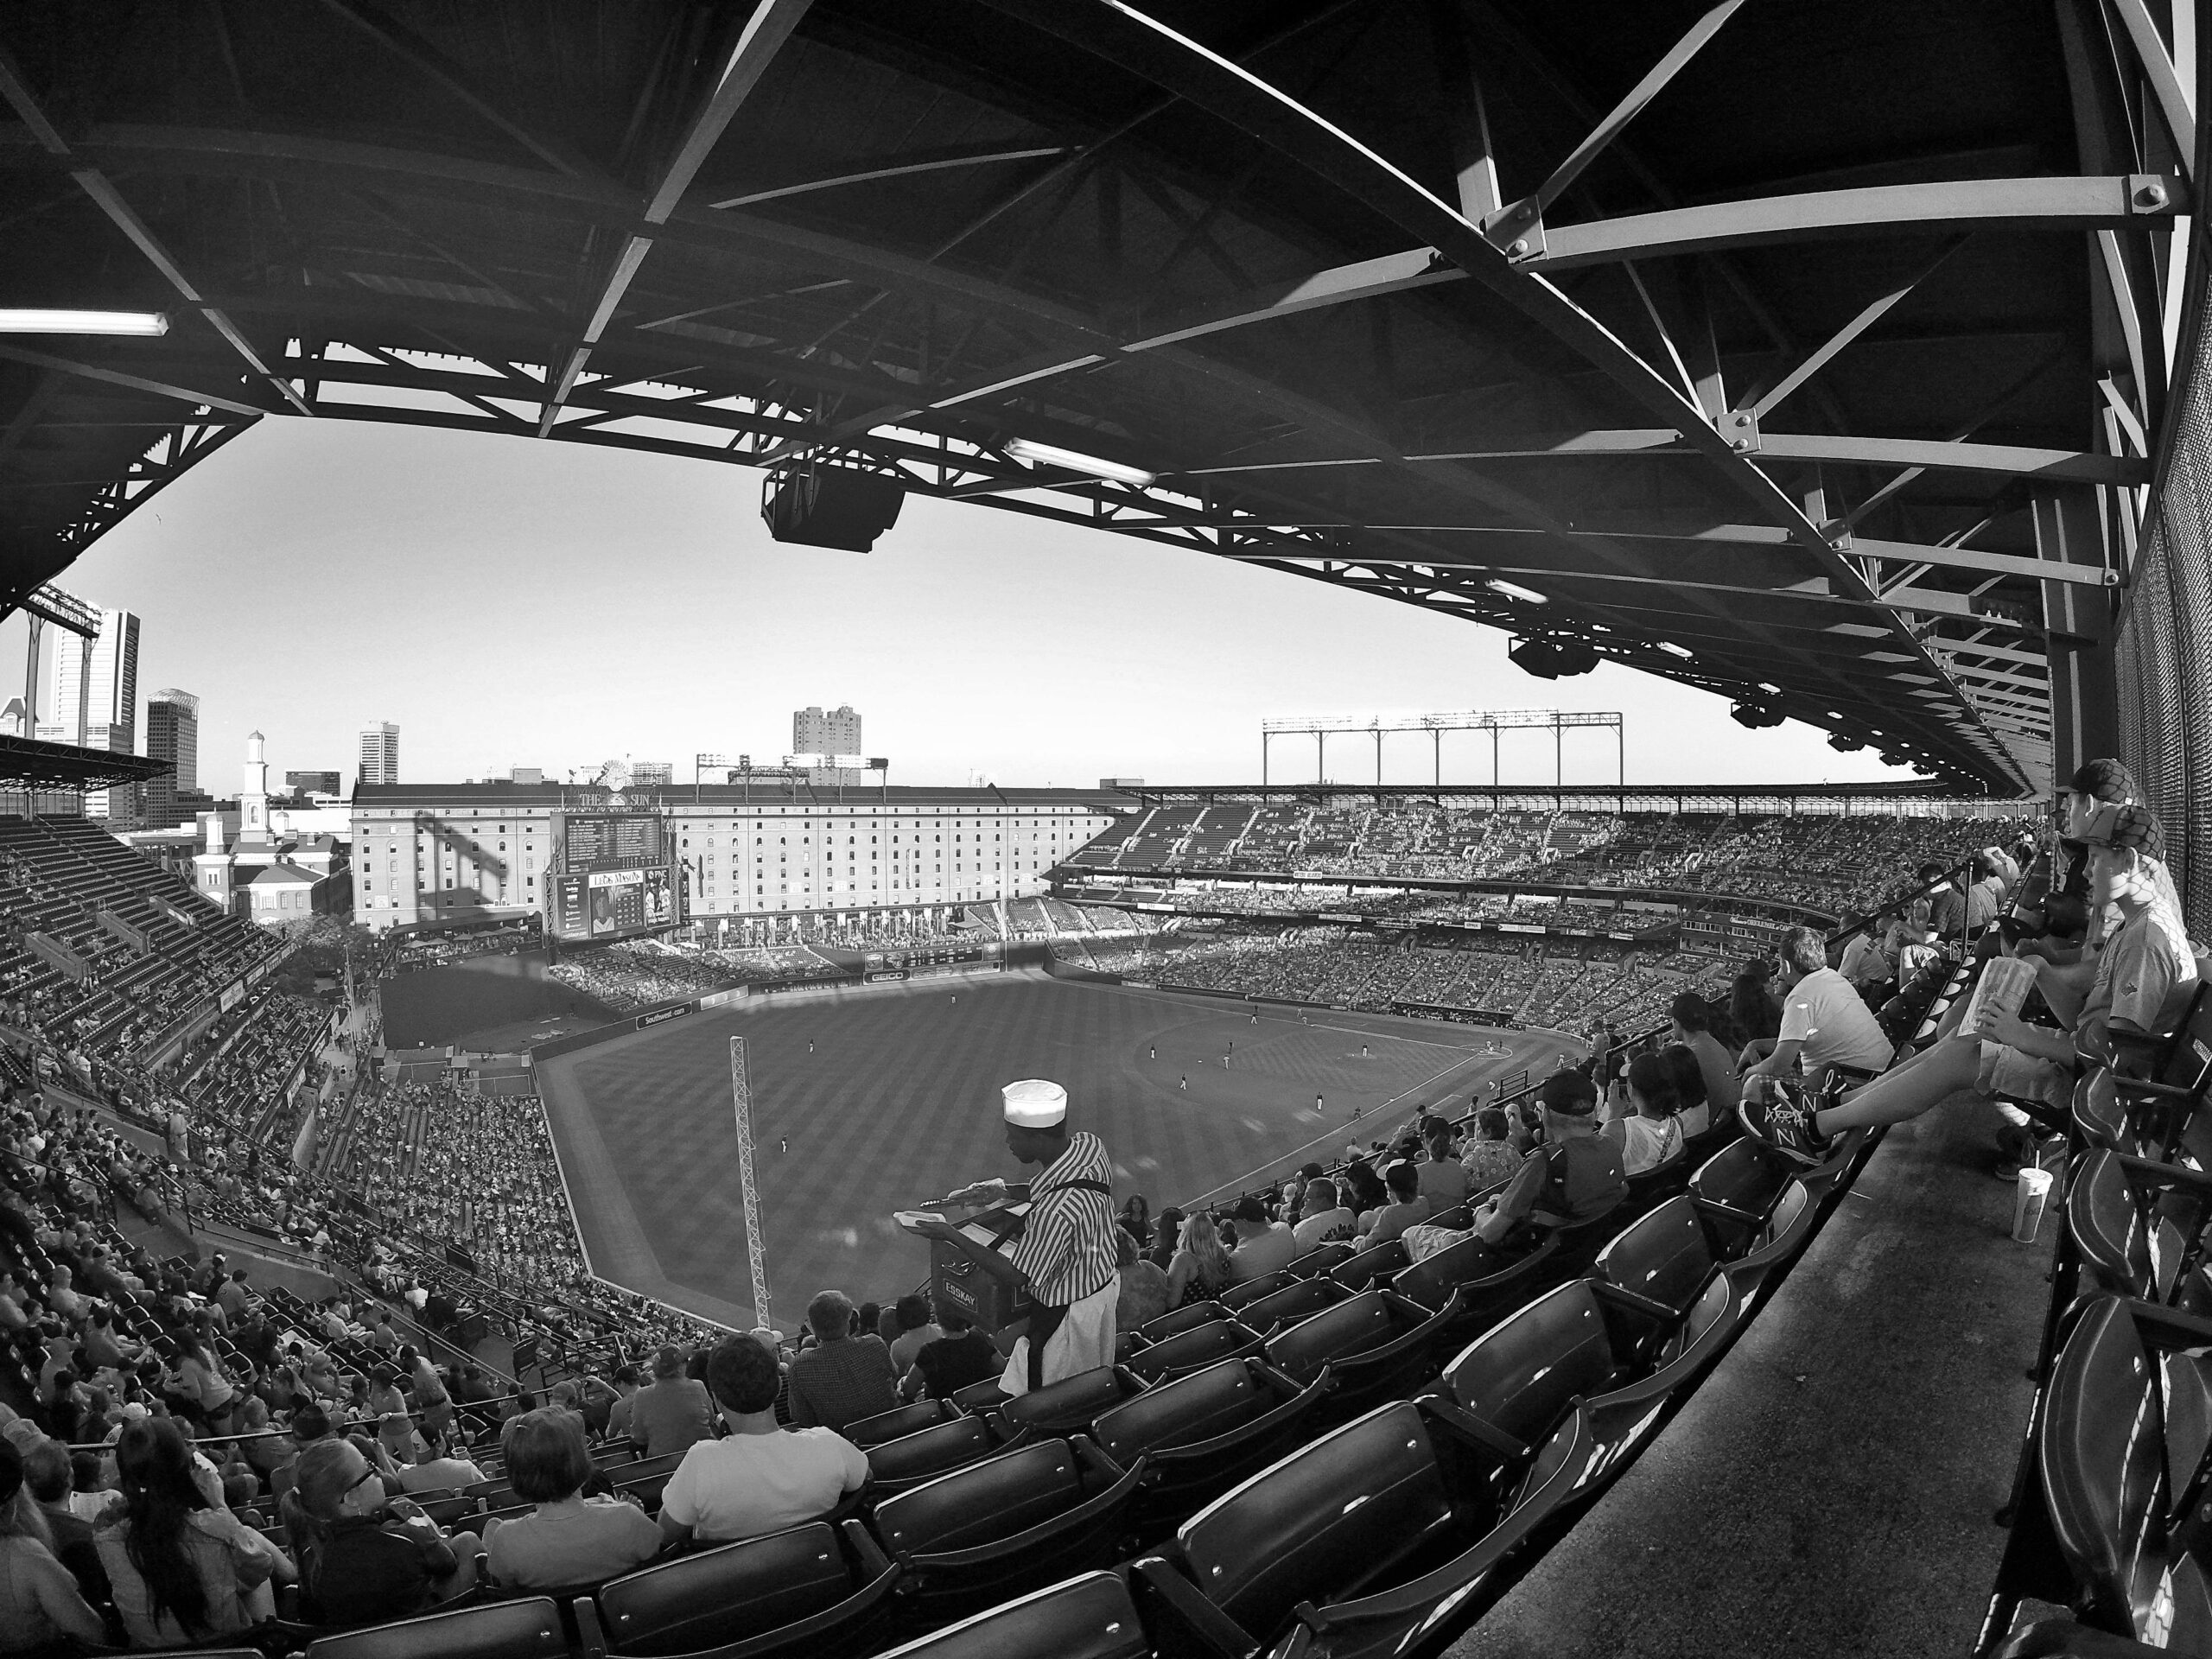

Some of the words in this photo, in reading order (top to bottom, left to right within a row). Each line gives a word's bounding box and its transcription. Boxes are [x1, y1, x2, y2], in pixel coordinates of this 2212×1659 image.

[580, 793, 602, 806] THE
[630, 794, 650, 806] SUN
[654, 869, 667, 879] PNC
[872, 972, 904, 982] GEICO
[1802, 1094, 1817, 1113] N
[1777, 1128, 1797, 1147] N
[945, 1281, 976, 1306] ESSKAY
